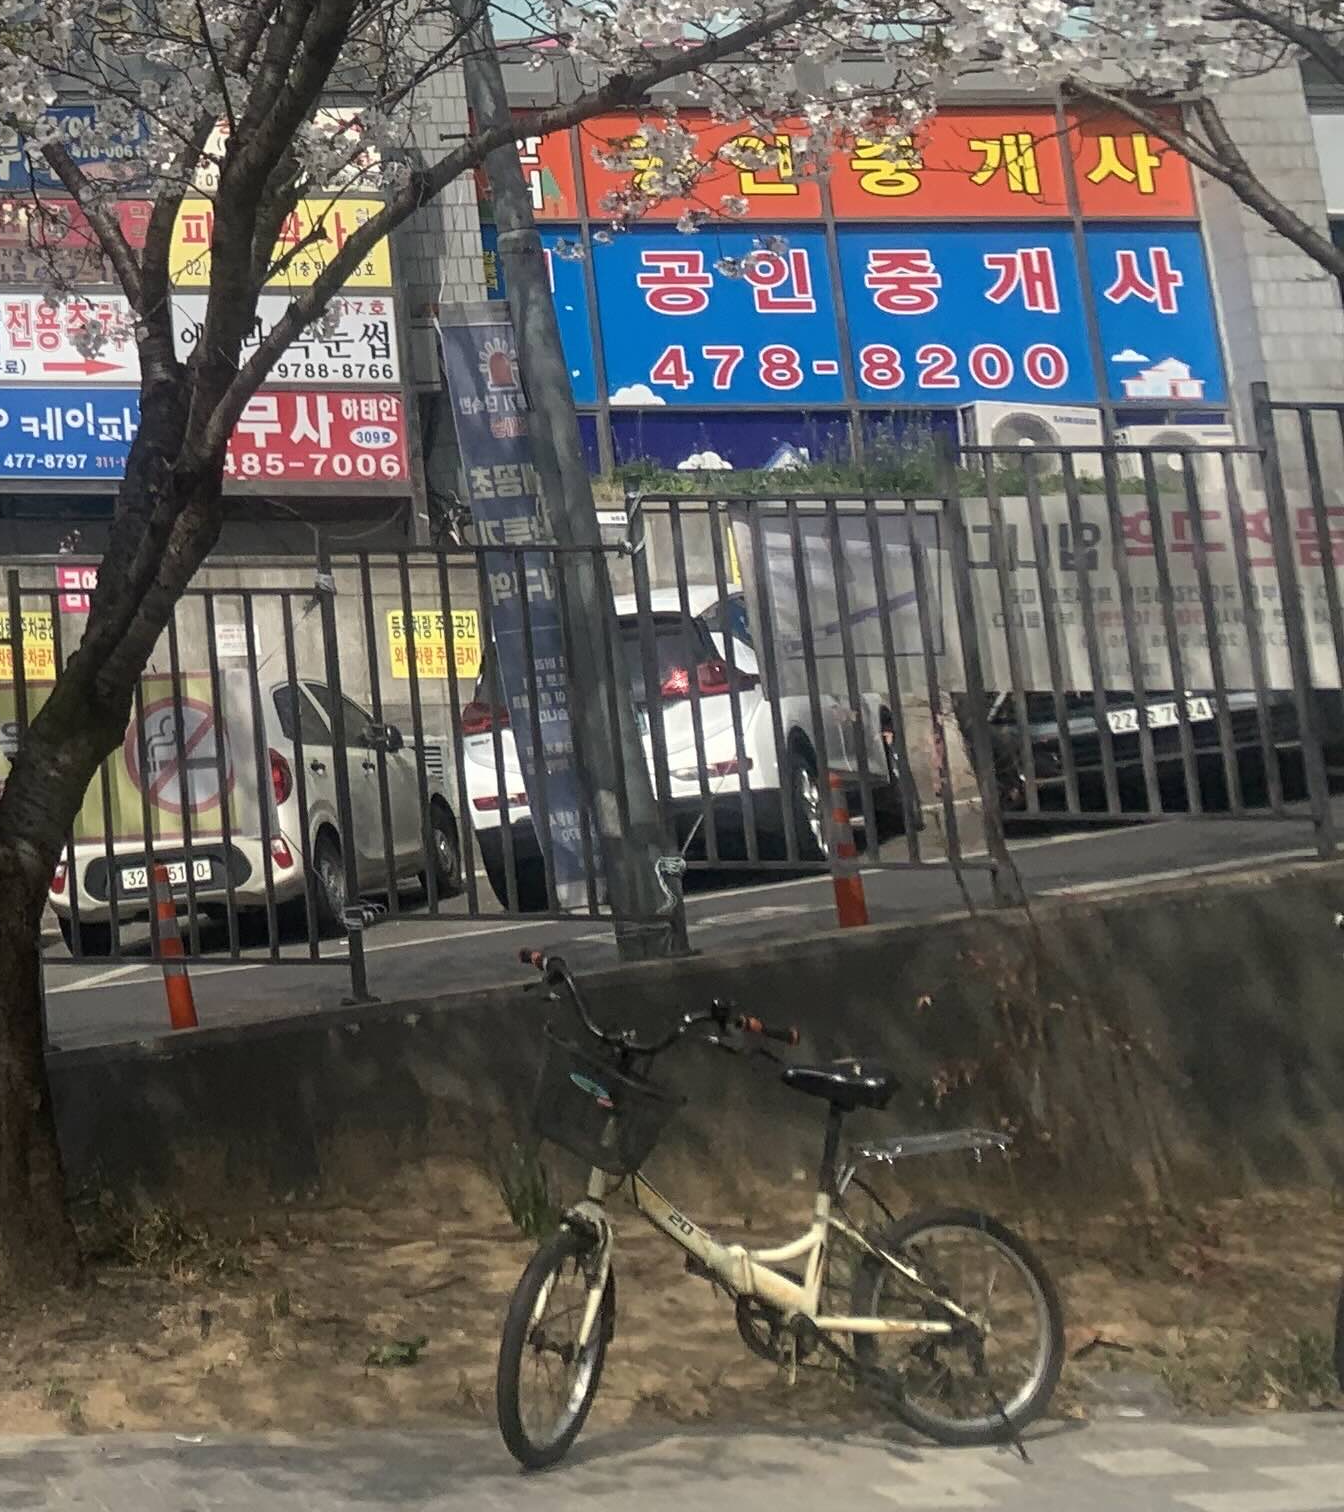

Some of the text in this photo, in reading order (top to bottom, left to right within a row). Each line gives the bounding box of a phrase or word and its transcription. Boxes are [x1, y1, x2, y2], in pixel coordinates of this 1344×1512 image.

[637, 247, 1184, 315] 공인중개사
[649, 343, 1069, 390] 478-8200
[341, 398, 400, 423] 하태안
[4, 454, 89, 470] 477-8797
